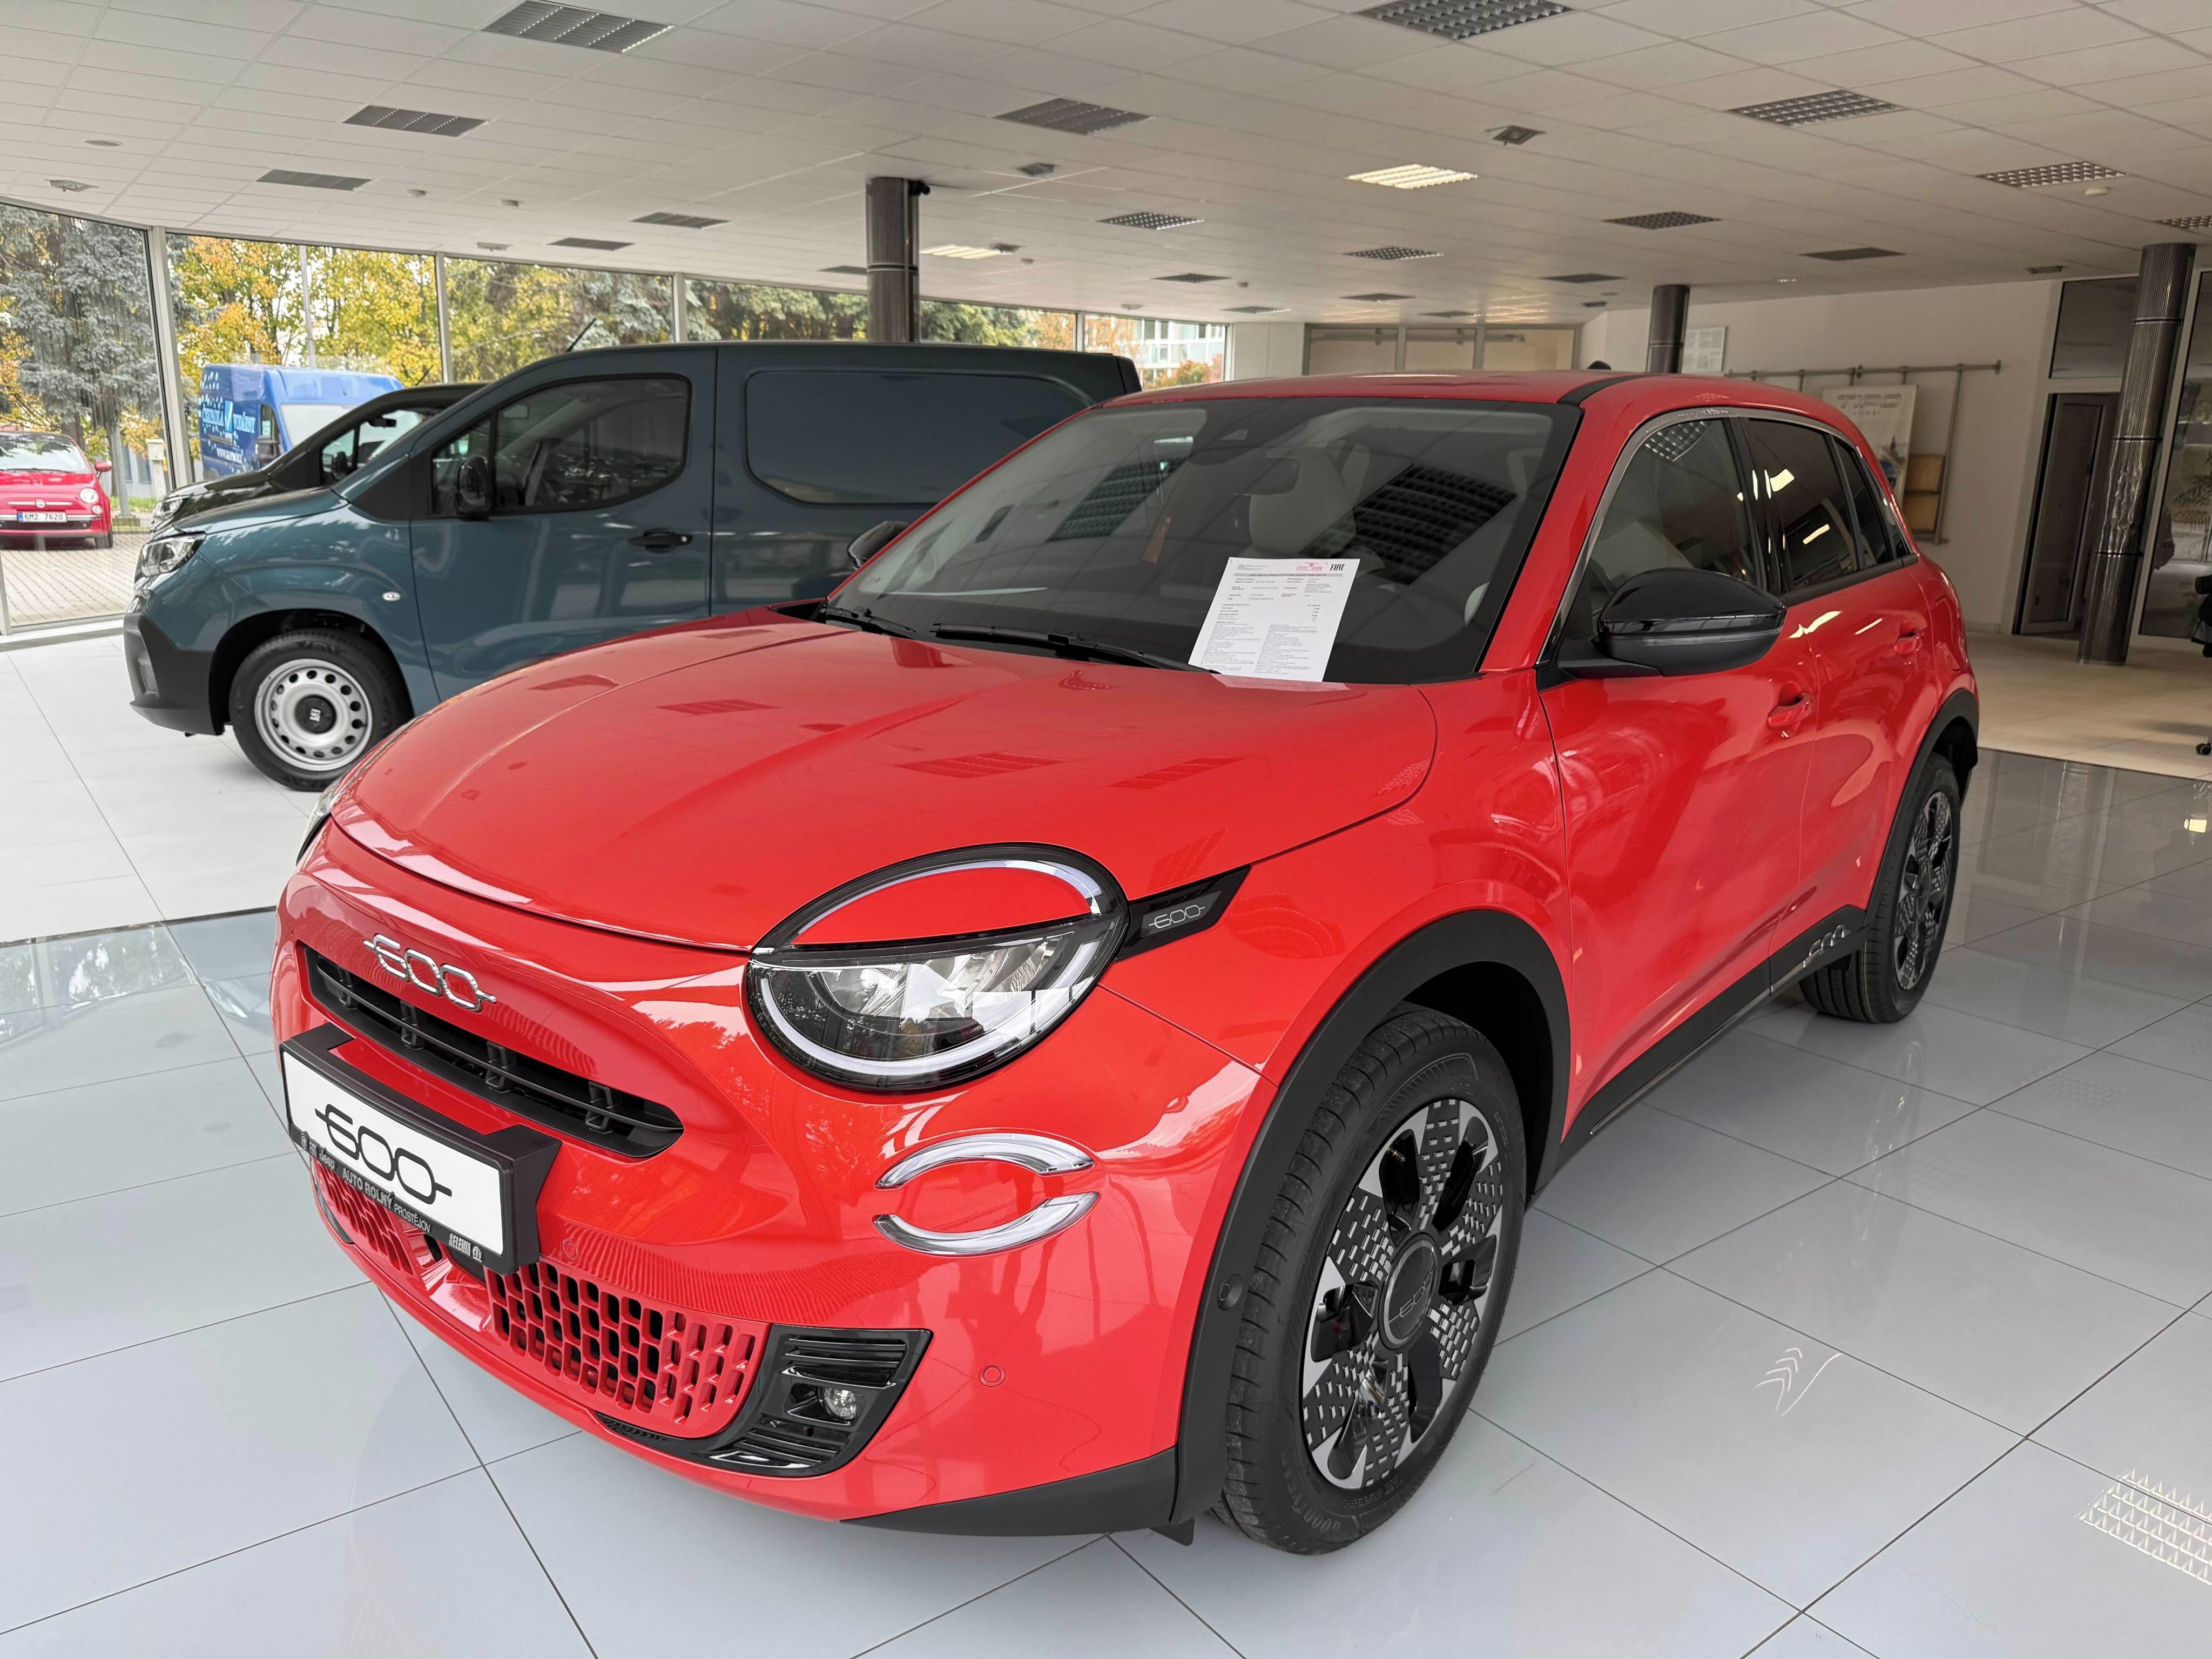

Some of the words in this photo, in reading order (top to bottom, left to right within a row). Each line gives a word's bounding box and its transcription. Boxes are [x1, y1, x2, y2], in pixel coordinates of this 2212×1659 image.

[1837, 394, 1901, 409] TIPO
[1149, 905, 1205, 928] 600
[363, 933, 497, 1013] 600
[314, 1103, 453, 1205] 600
[319, 1150, 335, 1171] Jeep
[342, 1167, 363, 1190] AUTO
[365, 1181, 393, 1209] ROLNÝ
[394, 1203, 430, 1233] PROSTĚJOV
[449, 1233, 471, 1257] SELENIA
